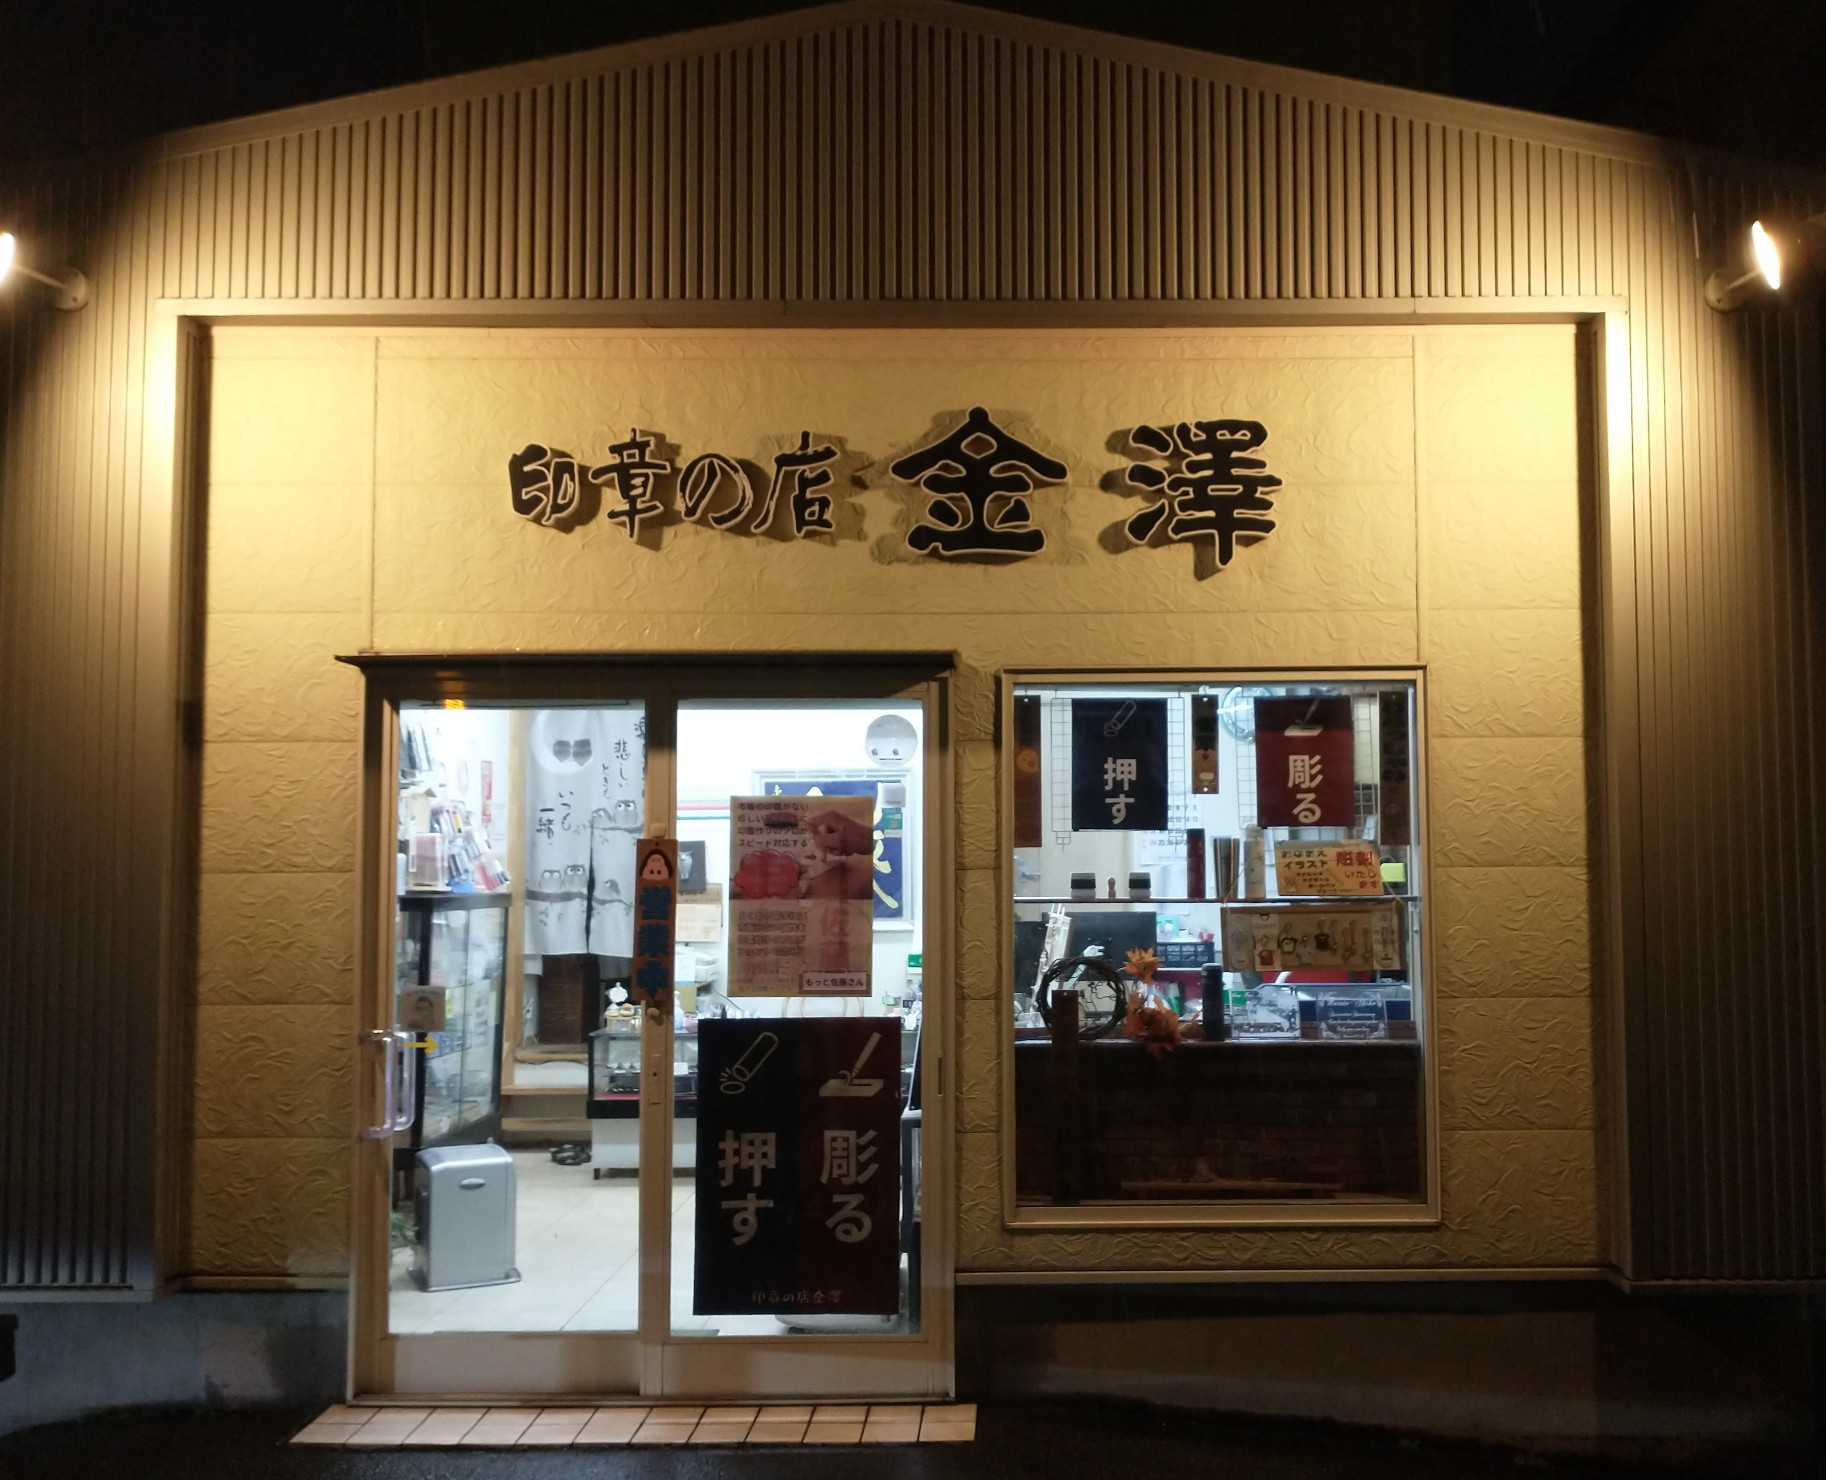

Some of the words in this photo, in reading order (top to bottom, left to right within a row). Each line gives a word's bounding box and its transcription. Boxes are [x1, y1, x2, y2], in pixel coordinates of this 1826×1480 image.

[889, 406, 1284, 568] 金澤
[1103, 757, 1137, 825] 押す
[1287, 754, 1324, 823] 彫る
[1284, 860, 1328, 870] イラスト
[805, 977, 864, 987] もっと佐藤さん
[718, 1129, 777, 1246] 押す
[819, 1129, 880, 1243] 彫る
